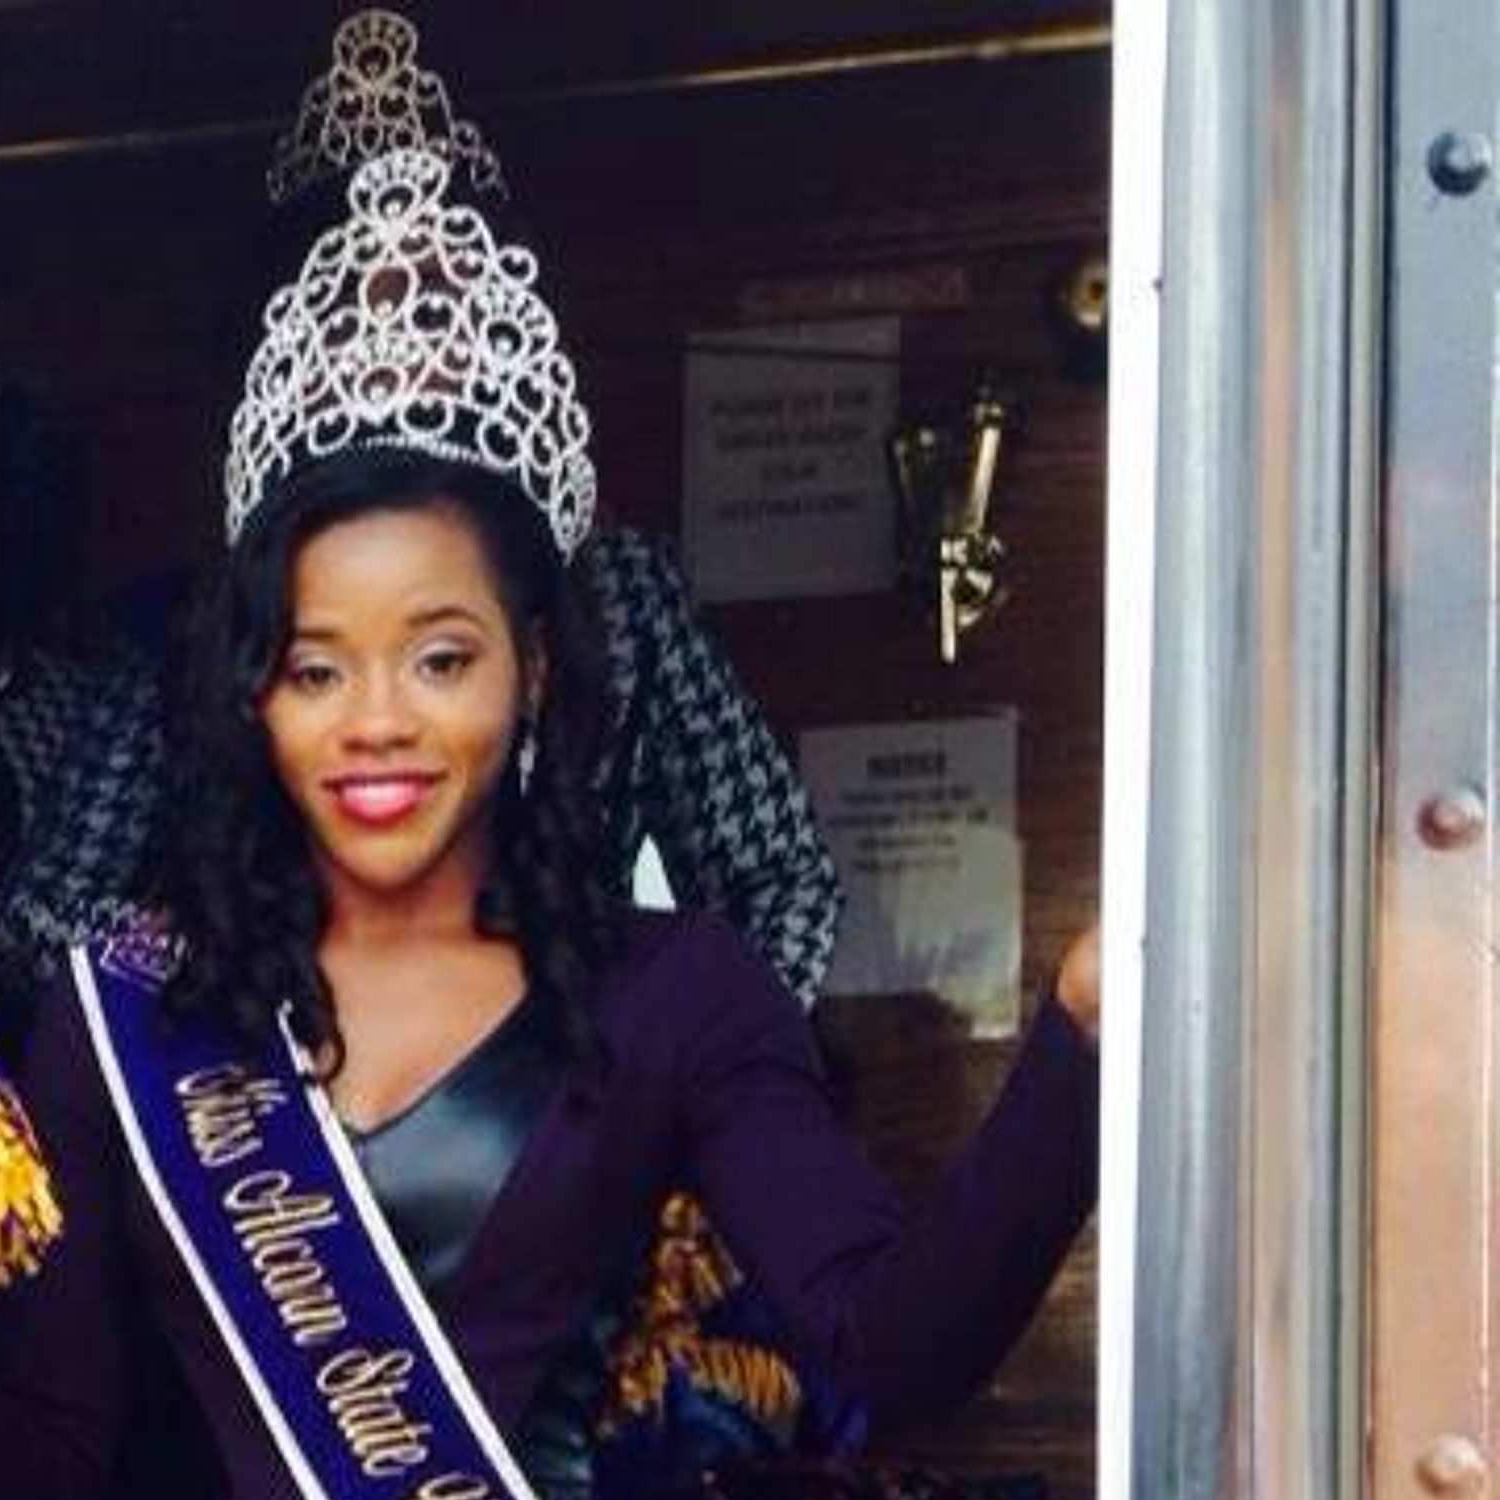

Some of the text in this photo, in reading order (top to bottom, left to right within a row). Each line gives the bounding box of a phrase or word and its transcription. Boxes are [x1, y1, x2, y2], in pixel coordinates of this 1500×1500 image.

[175, 1065, 288, 1168] Miss
[223, 1169, 347, 1347] Alcorn
[316, 1349, 434, 1477] State
